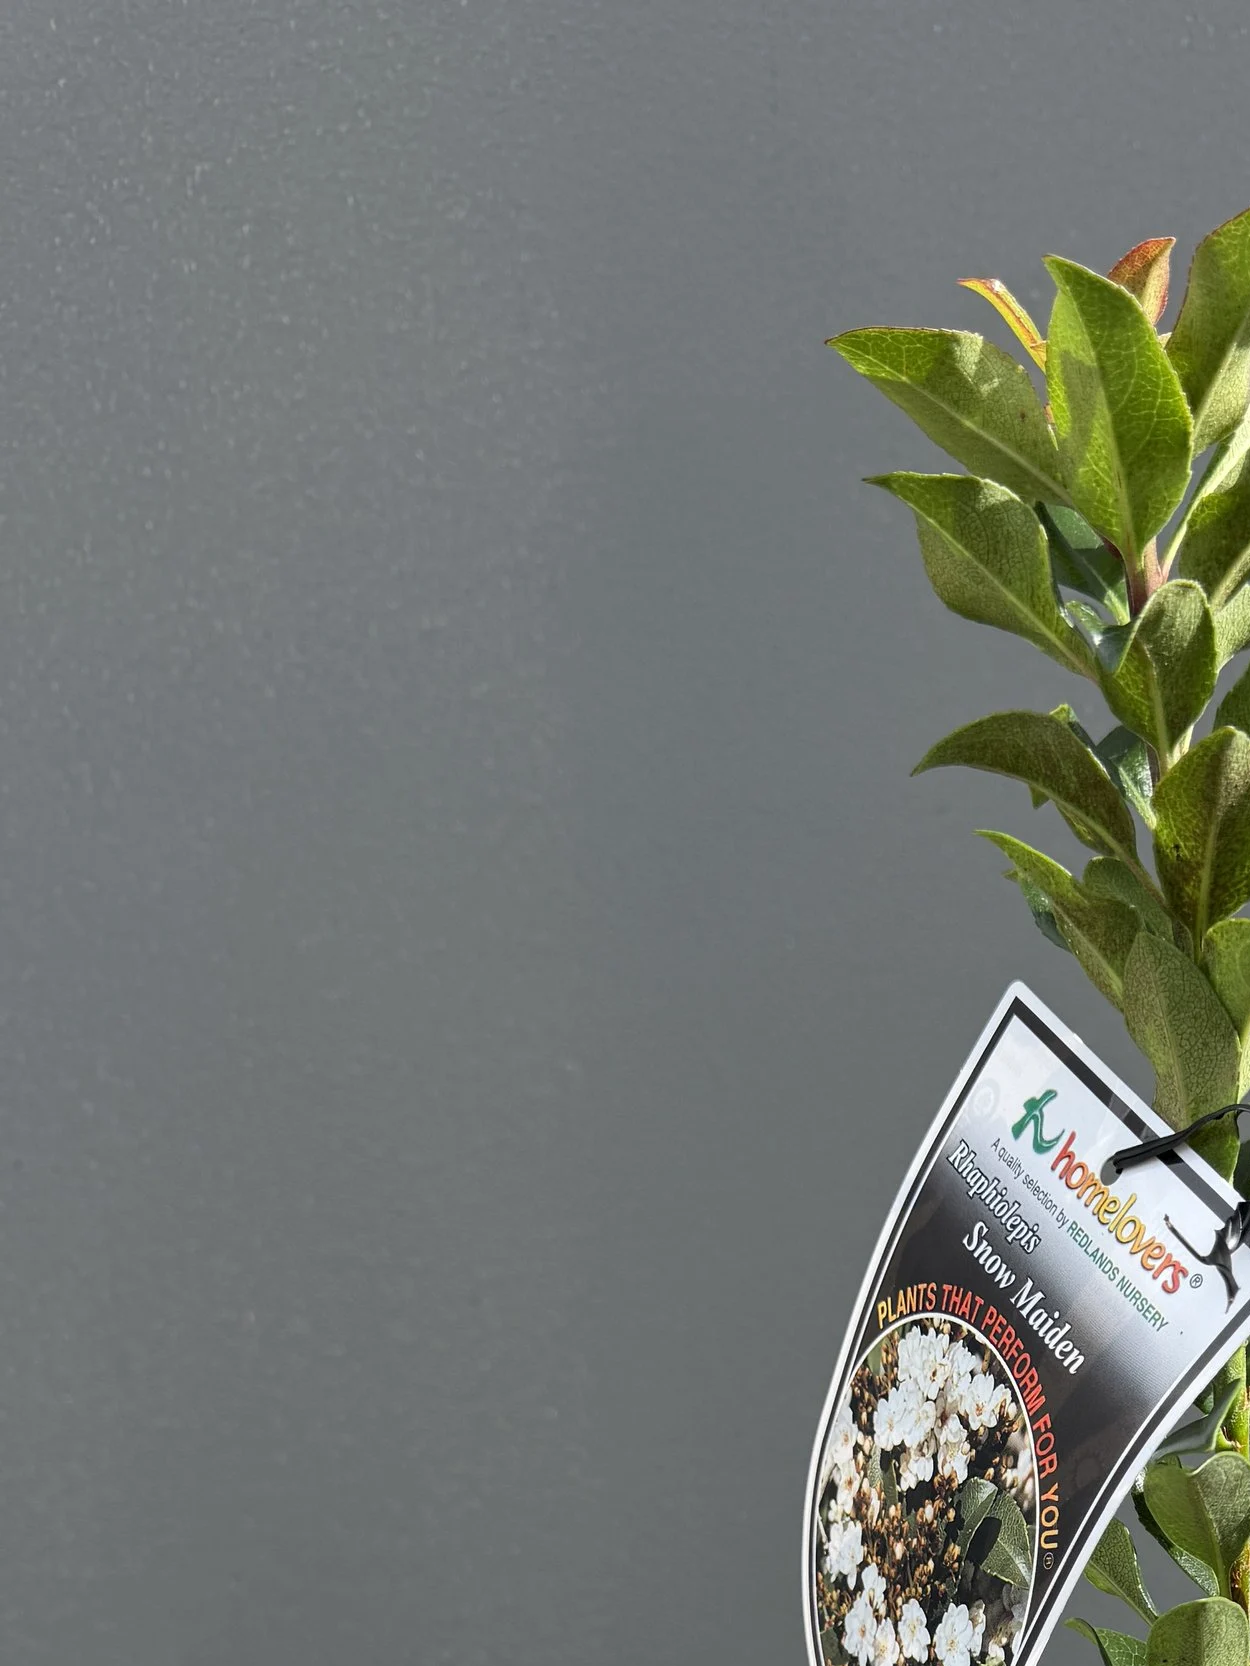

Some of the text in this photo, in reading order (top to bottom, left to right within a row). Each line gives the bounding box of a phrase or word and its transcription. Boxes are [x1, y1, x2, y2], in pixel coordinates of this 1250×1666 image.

[947, 1139, 1042, 1256] Rhaphiolepis
[991, 1137, 1169, 1332] A quality selection by REDLANDS NURSERY
[877, 1282, 937, 1330] PLANTS
[940, 1284, 985, 1324] THAT
[982, 1306, 1047, 1417] PERFORM
[1032, 1412, 1059, 1479] FOR
[962, 1221, 1086, 1375] Snow Maiden
